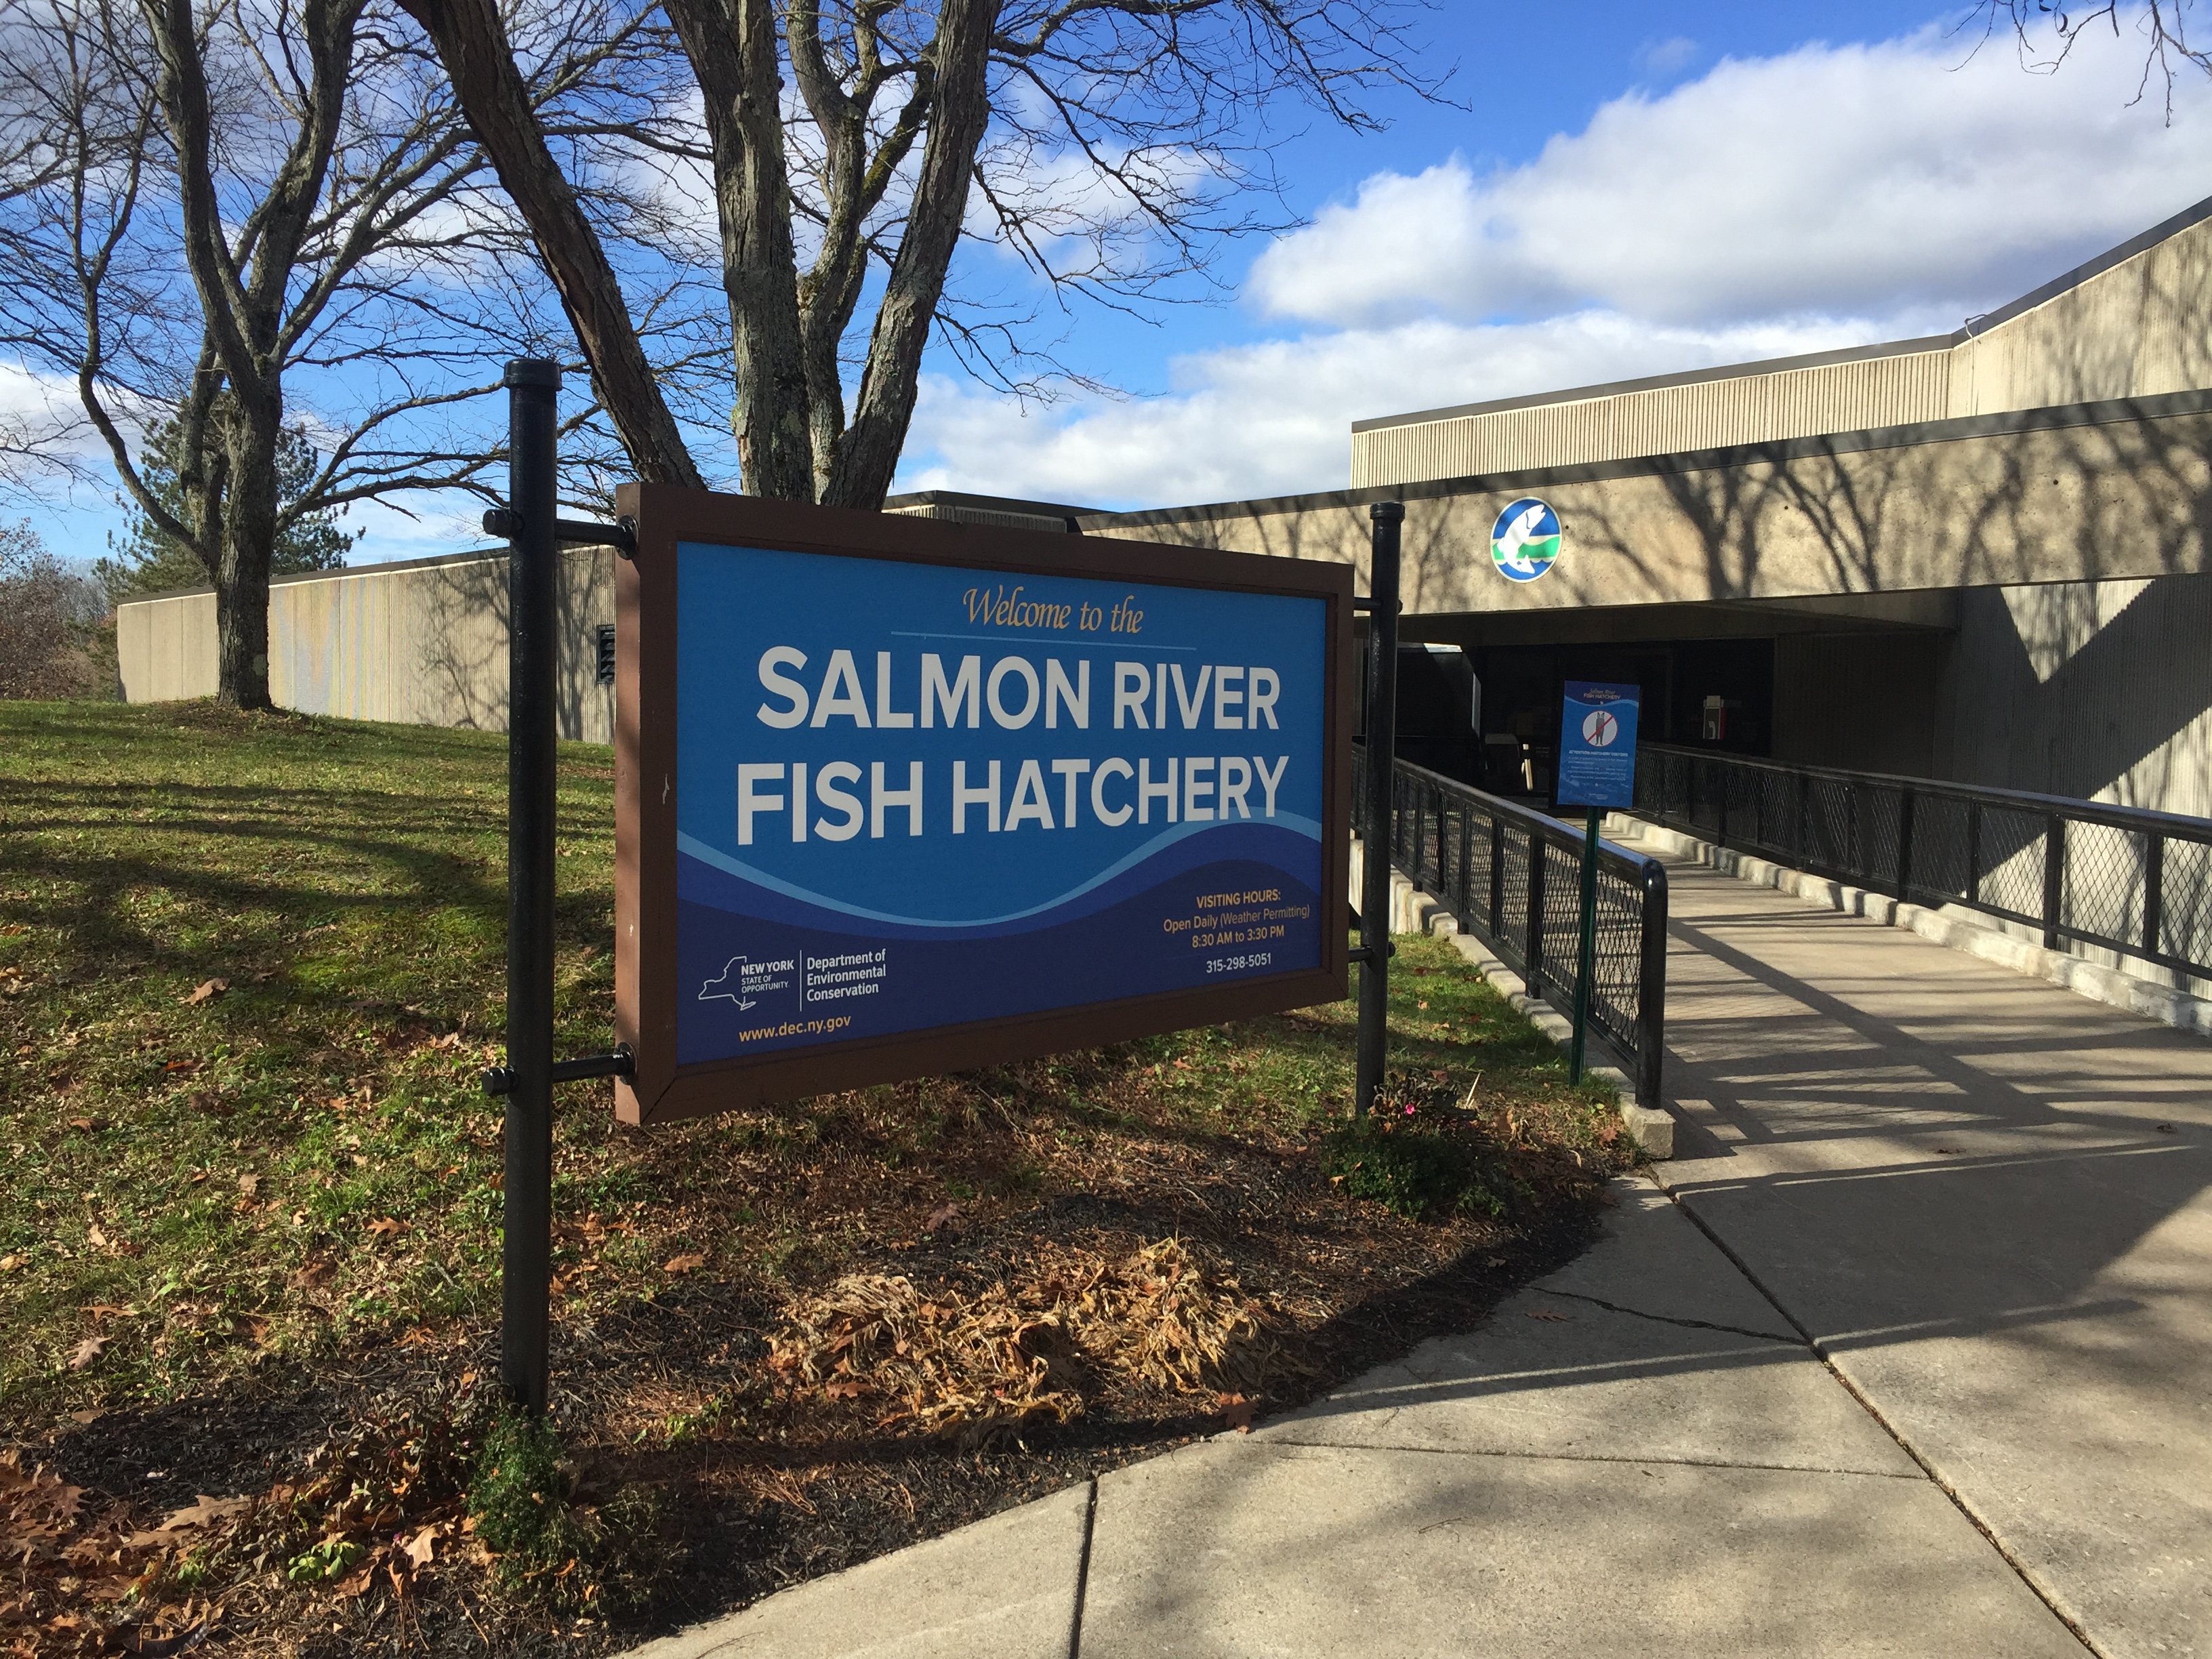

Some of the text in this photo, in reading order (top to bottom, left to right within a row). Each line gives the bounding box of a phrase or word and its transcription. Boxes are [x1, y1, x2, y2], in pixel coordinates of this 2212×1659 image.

[963, 585, 1143, 633] Welcome to the
[757, 646, 1279, 729] SALMON RIVER
[738, 756, 1289, 845] FISH HATCHERY
[1197, 889, 1281, 908] VISITING HOURS:
[1164, 904, 1310, 933] Open Daily (Weather Permitting)
[1192, 925, 1284, 947] 8:30 AM to 3:30 PM
[741, 960, 794, 976] NEW YORK
[807, 948, 886, 972] Department of
[1206, 953, 1271, 973] 315-298-5051
[741, 975, 773, 985] STATE OF
[807, 964, 886, 986] Environmental
[741, 981, 788, 993] OPPORTUNITY
[807, 983, 879, 1002] Conservation
[739, 1016, 851, 1042] www.dec.ny.gov
